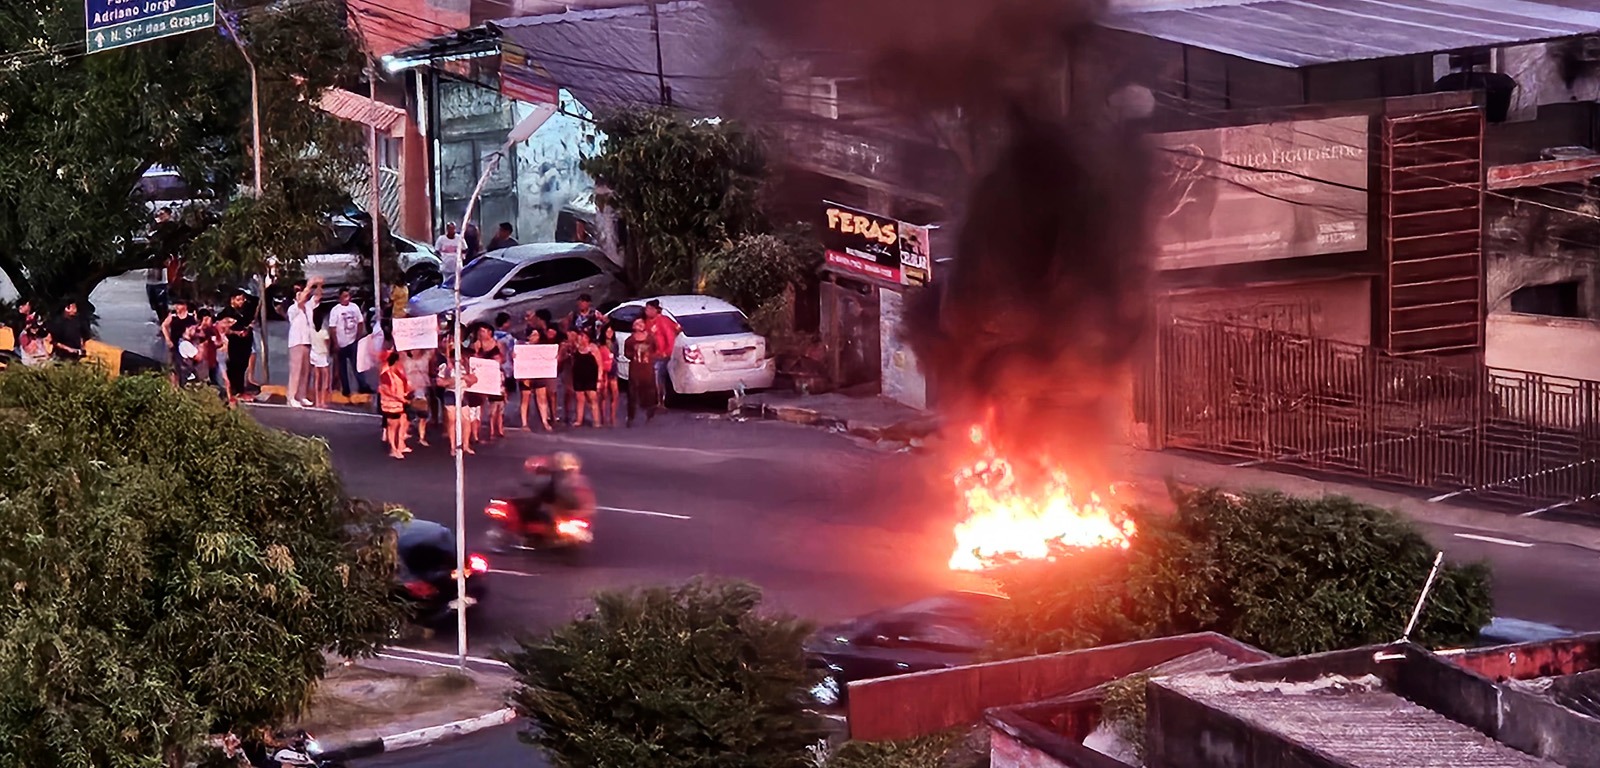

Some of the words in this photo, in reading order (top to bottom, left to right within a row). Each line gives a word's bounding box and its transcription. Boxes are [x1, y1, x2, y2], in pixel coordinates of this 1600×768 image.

[93, 7, 139, 24] Adriano
[143, 0, 176, 14] Jorge
[170, 11, 210, 28] Graças
[826, 208, 897, 244] FERAS
